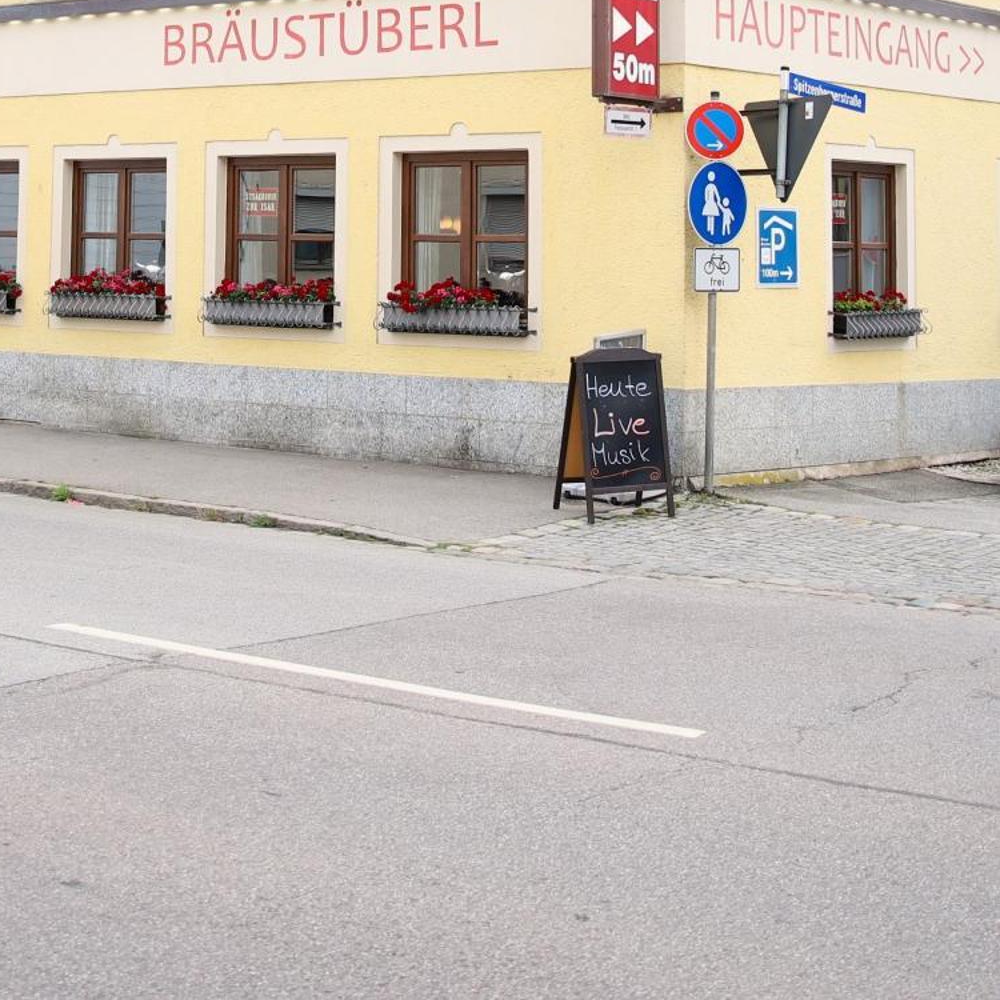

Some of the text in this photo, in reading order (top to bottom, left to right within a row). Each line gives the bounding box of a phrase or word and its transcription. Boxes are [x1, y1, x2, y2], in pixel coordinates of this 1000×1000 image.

[163, 0, 500, 67] BRÄUSTÜBERL
[612, 51, 656, 86] 50m
[709, 275, 725, 287] frei
[585, 372, 652, 400] Heute
[593, 407, 651, 438] Live
[591, 439, 650, 467] Musik
